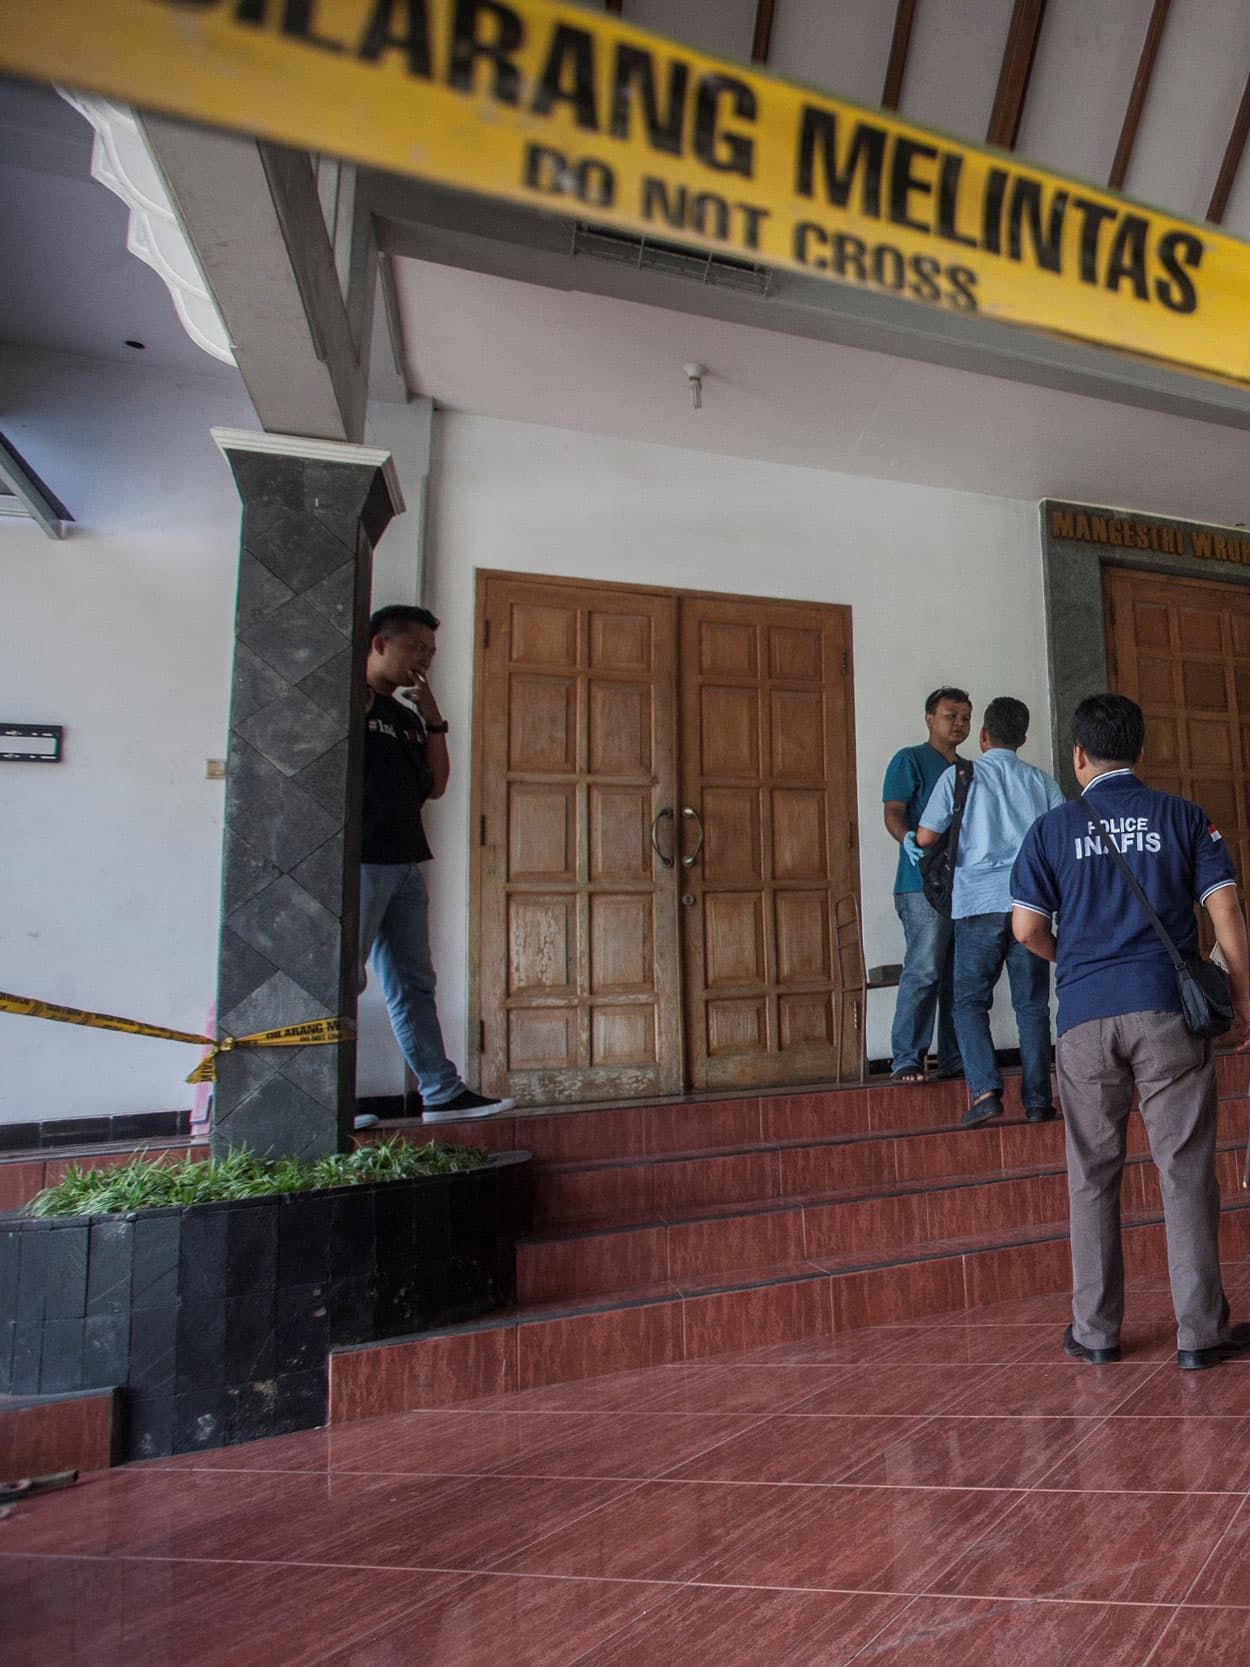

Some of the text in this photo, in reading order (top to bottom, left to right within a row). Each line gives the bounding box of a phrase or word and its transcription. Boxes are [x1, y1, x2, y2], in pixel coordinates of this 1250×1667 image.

[165, 0, 1204, 315] LARANG MELINTAS
[524, 142, 979, 313] DO NOT CROSS
[1052, 511, 1184, 556] MANGESTHI
[1074, 832, 1161, 860] INAFIS
[1087, 817, 1149, 835] POLICE
